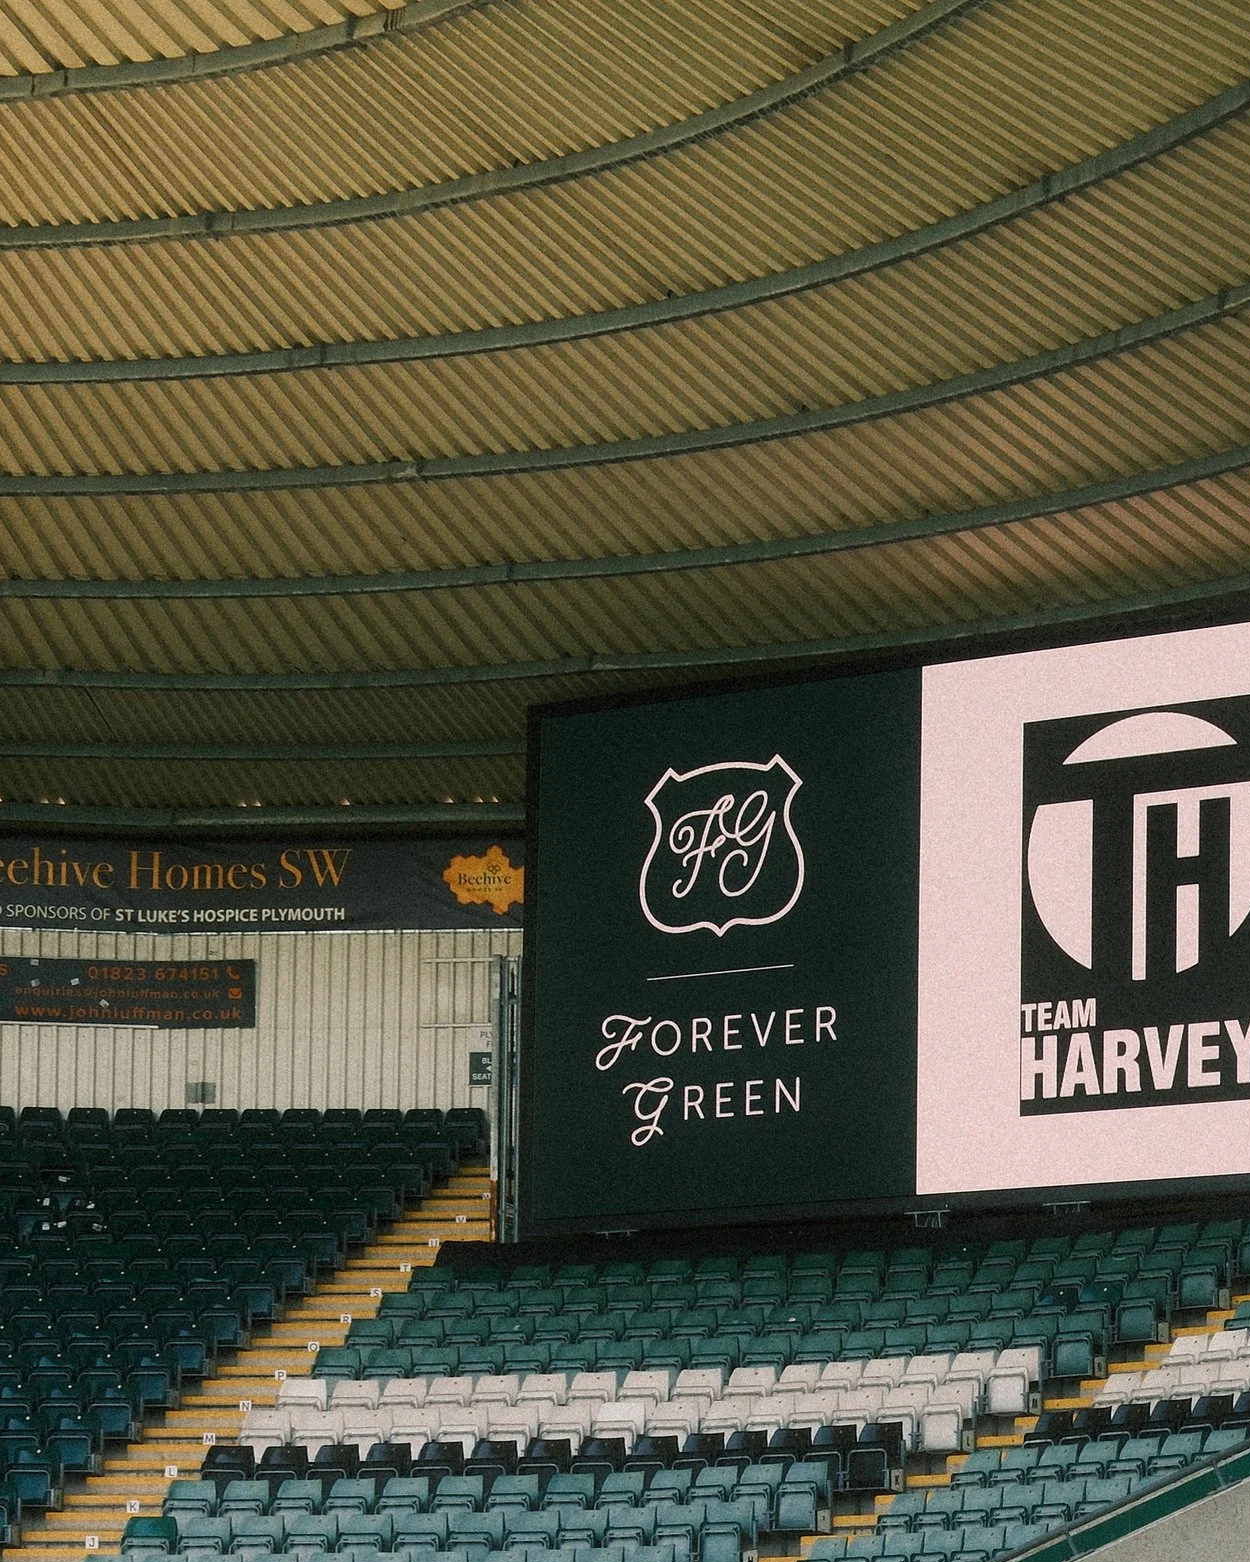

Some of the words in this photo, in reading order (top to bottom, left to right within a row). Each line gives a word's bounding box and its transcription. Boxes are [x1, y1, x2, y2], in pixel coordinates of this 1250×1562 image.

[0, 847, 114, 889] ehive
[127, 850, 267, 890] Homes
[279, 848, 353, 889] SW
[458, 872, 512, 885] Beehive
[6, 904, 87, 920] SPONSORS
[90, 907, 111, 920] OF
[115, 909, 134, 922] ST
[138, 909, 190, 923] LUKE'S
[193, 908, 258, 922] HOSPICE
[262, 907, 345, 921] PLYMOUTH
[88, 966, 147, 981] 01823
[1020, 997, 1097, 1033] TEAM
[595, 1005, 838, 1071] FOREVER
[622, 1076, 802, 1146] GREEN
